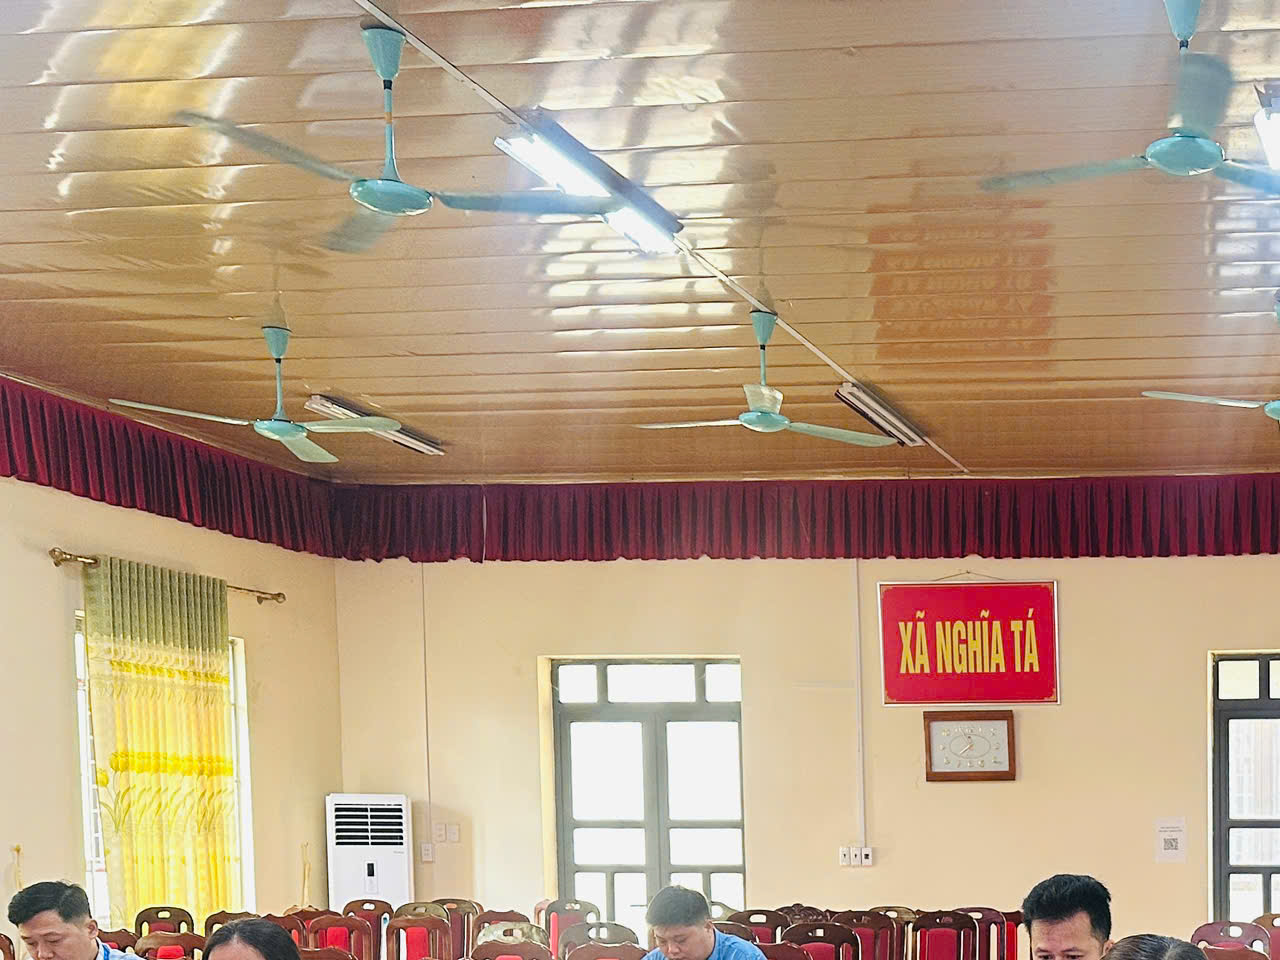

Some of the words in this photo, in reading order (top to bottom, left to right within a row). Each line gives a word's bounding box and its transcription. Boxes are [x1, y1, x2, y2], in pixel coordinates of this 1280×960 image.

[898, 610, 931, 674] XÃ
[935, 609, 1006, 674] NGHĨA
[1010, 607, 1041, 673] TÁ
